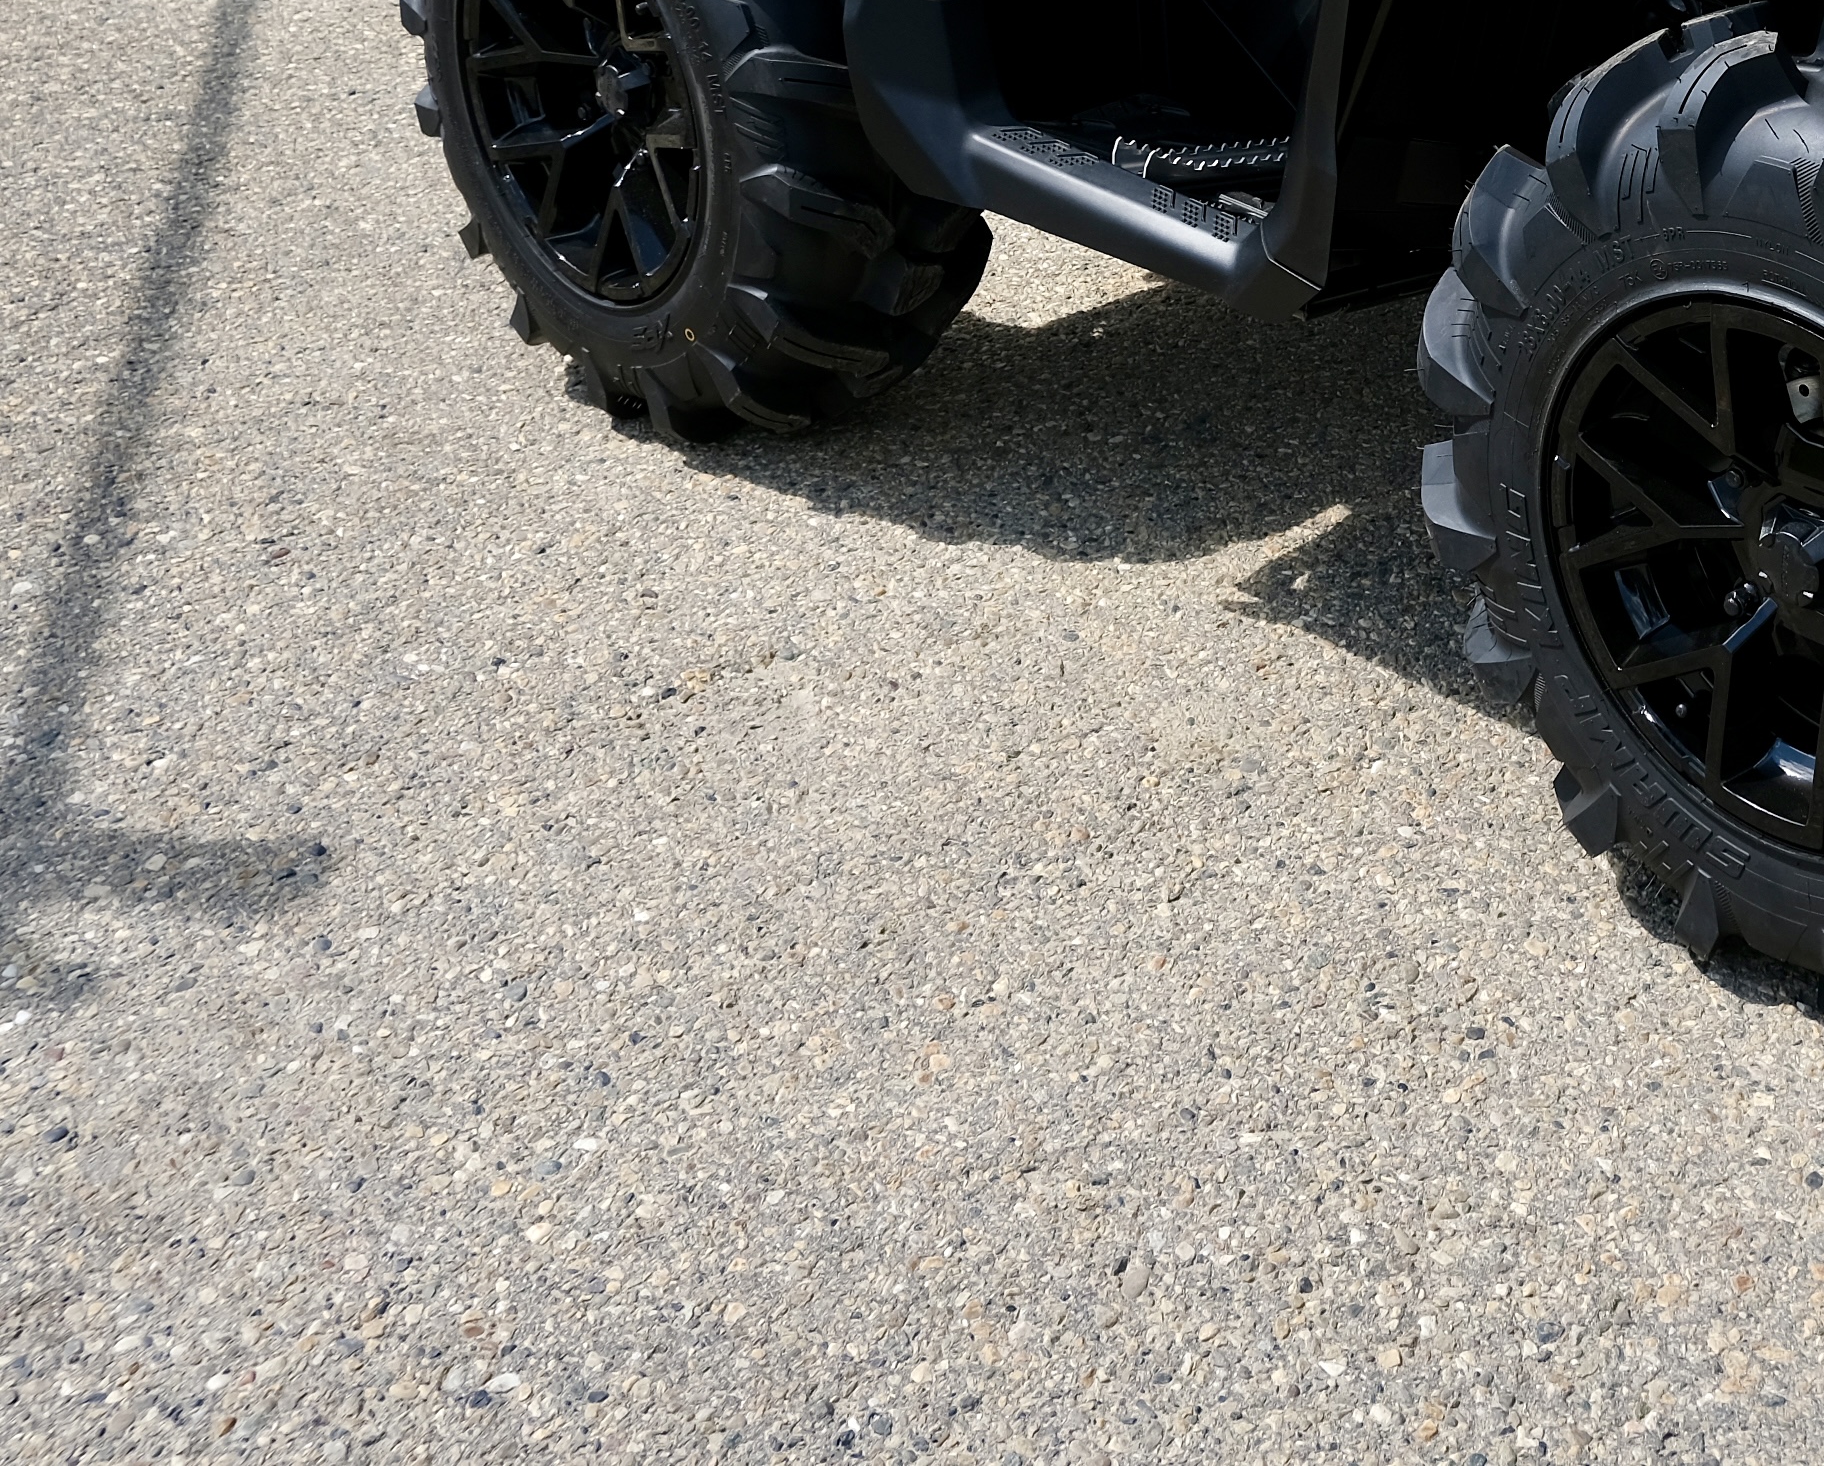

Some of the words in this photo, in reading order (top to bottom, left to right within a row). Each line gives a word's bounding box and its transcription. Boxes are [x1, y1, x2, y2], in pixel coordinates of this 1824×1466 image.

[1516, 265, 1590, 358] 28X8.00-14
[1593, 235, 1636, 272] MST
[1501, 481, 1562, 653] KING
[1554, 674, 1750, 879] SWAMP
